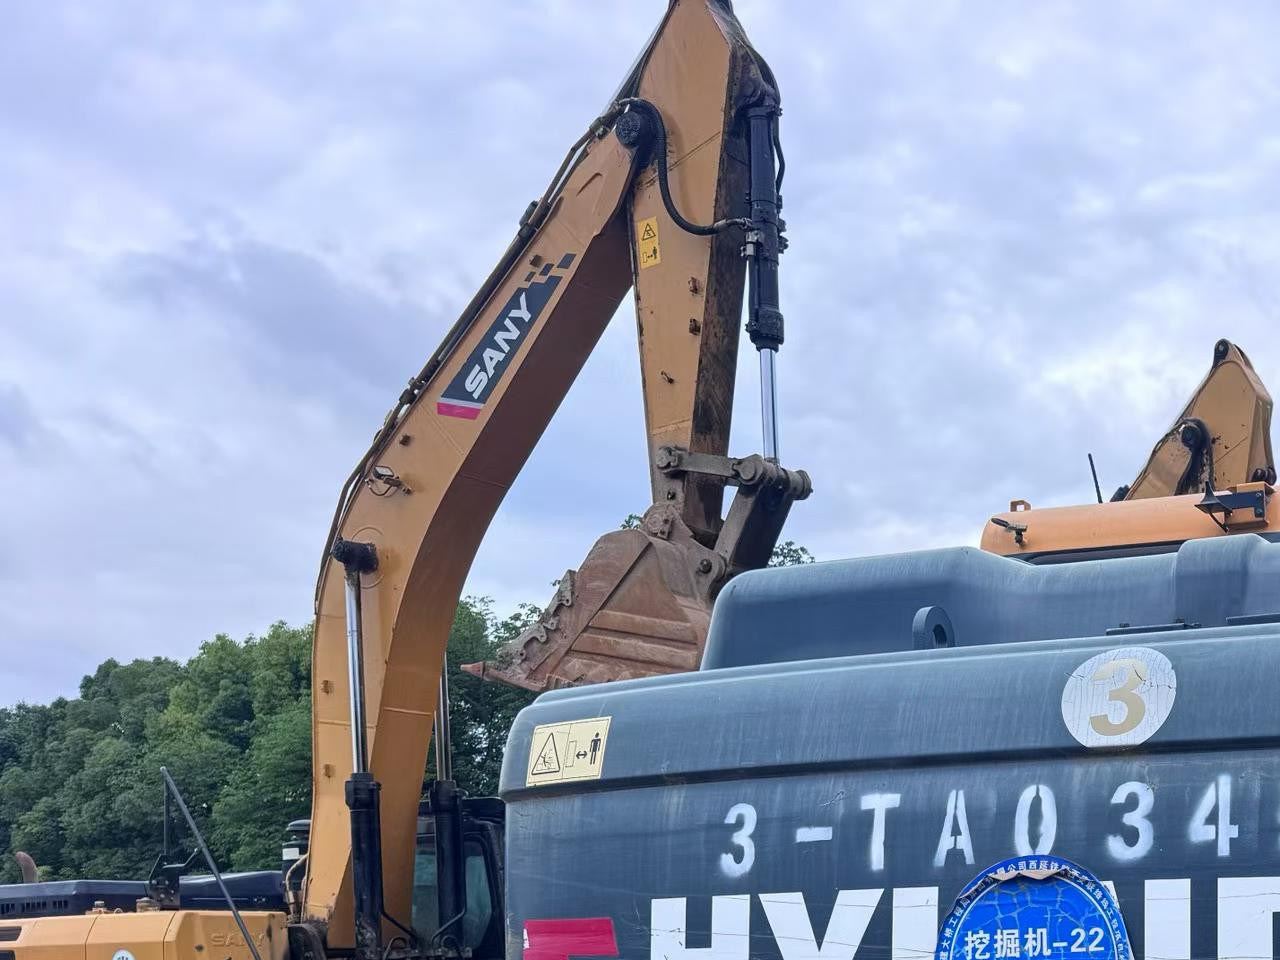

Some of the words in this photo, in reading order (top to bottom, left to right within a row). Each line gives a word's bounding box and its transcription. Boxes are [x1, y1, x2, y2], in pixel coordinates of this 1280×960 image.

[464, 292, 534, 399] SANY
[1089, 658, 1147, 736] 3
[964, 926, 1105, 960] 挖掘机-22
